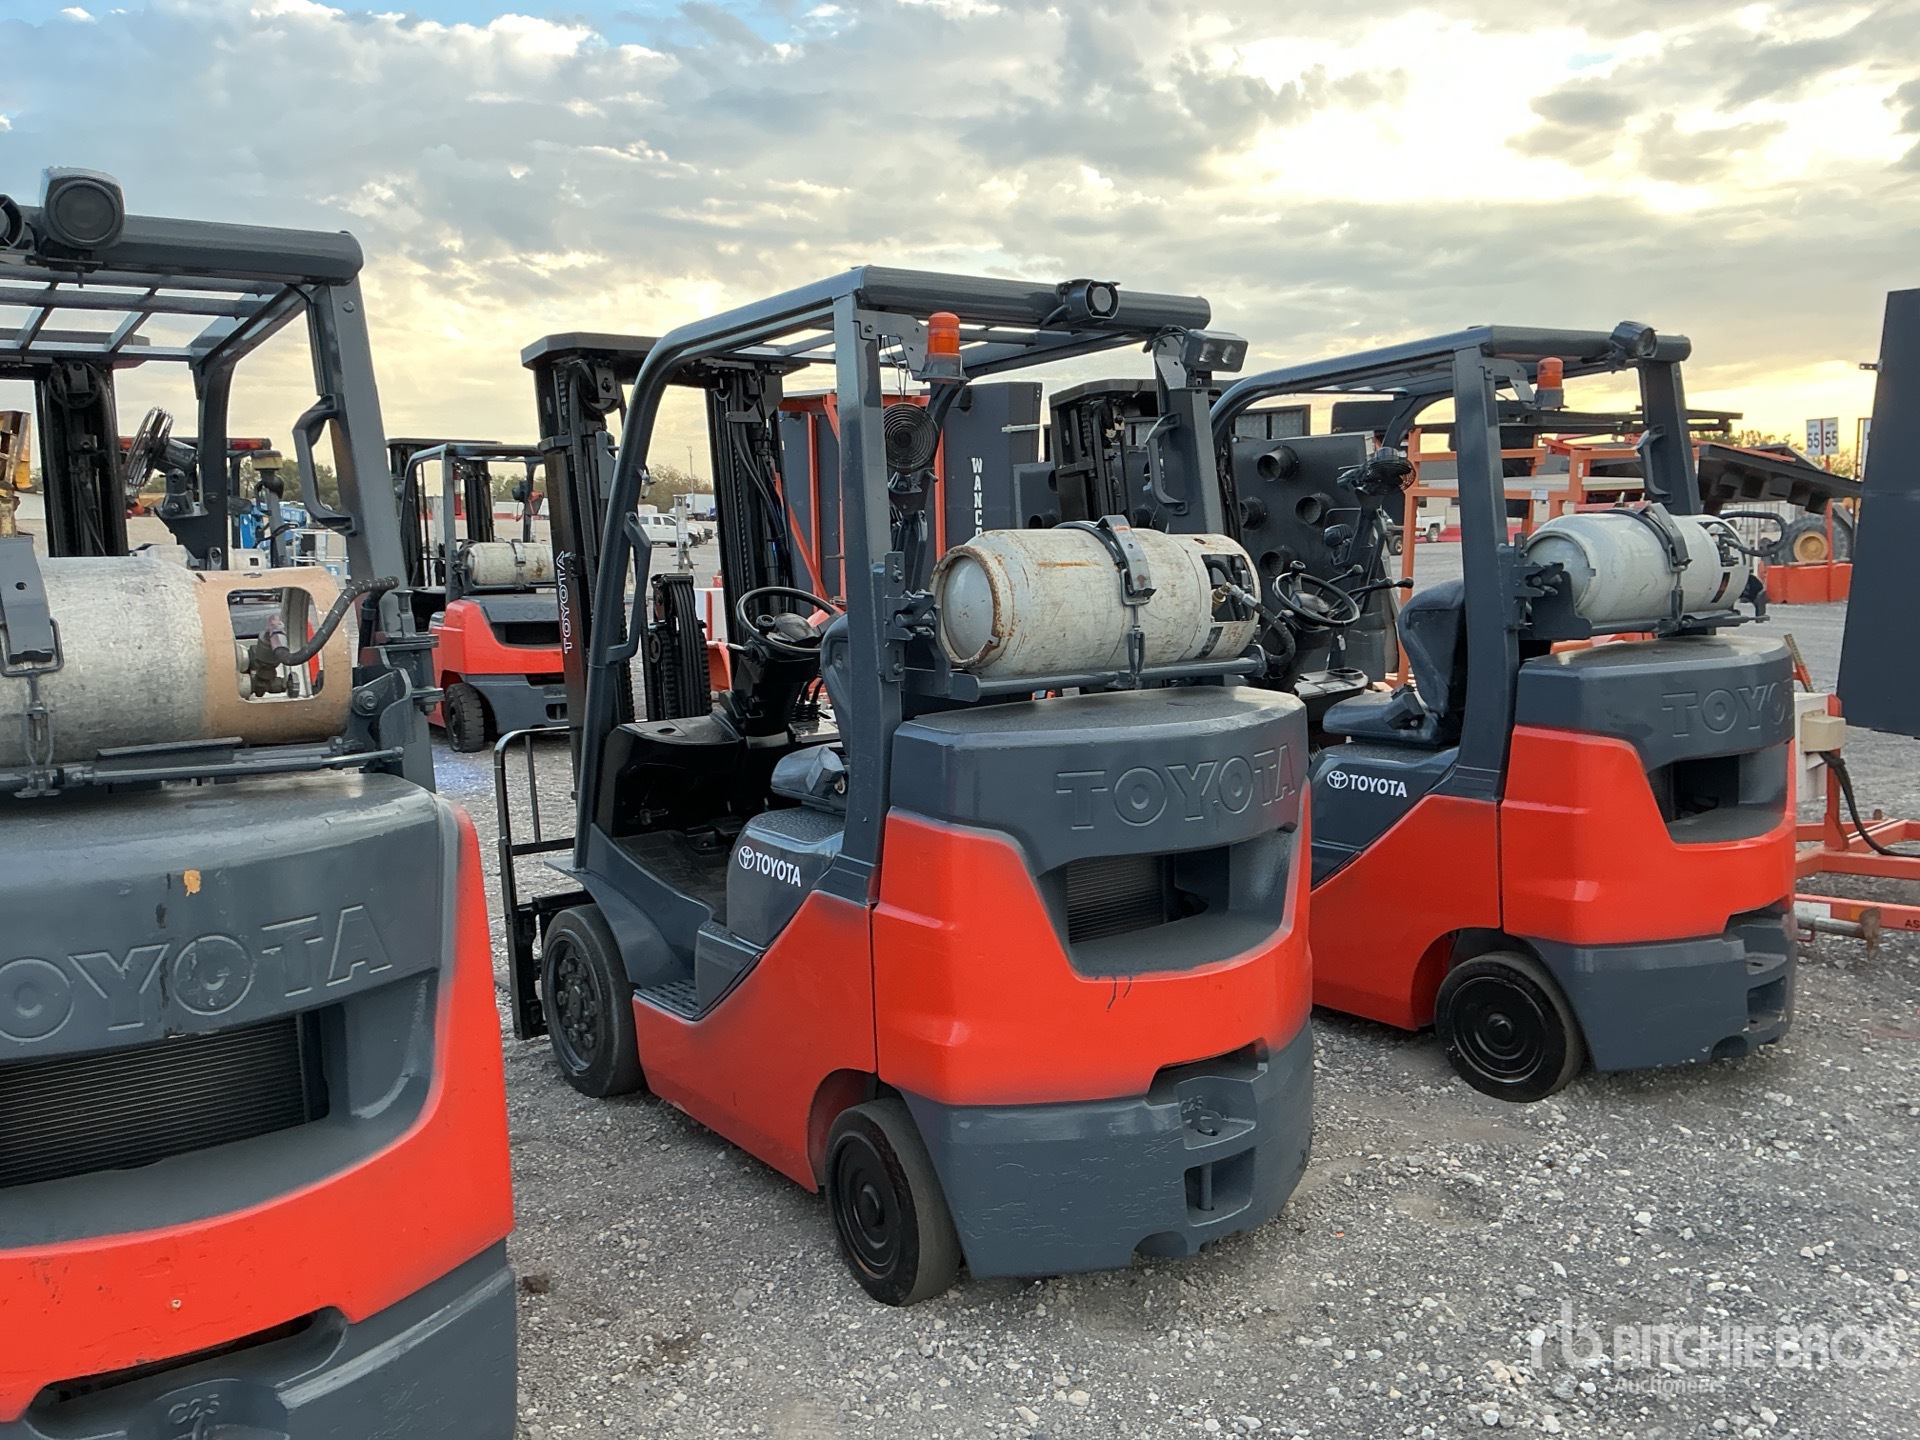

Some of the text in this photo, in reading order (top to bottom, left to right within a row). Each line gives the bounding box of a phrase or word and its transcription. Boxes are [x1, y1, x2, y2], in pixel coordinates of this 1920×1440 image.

[1825, 430, 1838, 448] 55
[556, 550, 573, 655] TOYOTA
[1055, 743, 1296, 831] TOYOTA
[1349, 774, 1408, 798] TOYOTA
[755, 851, 802, 888] TOYOTA
